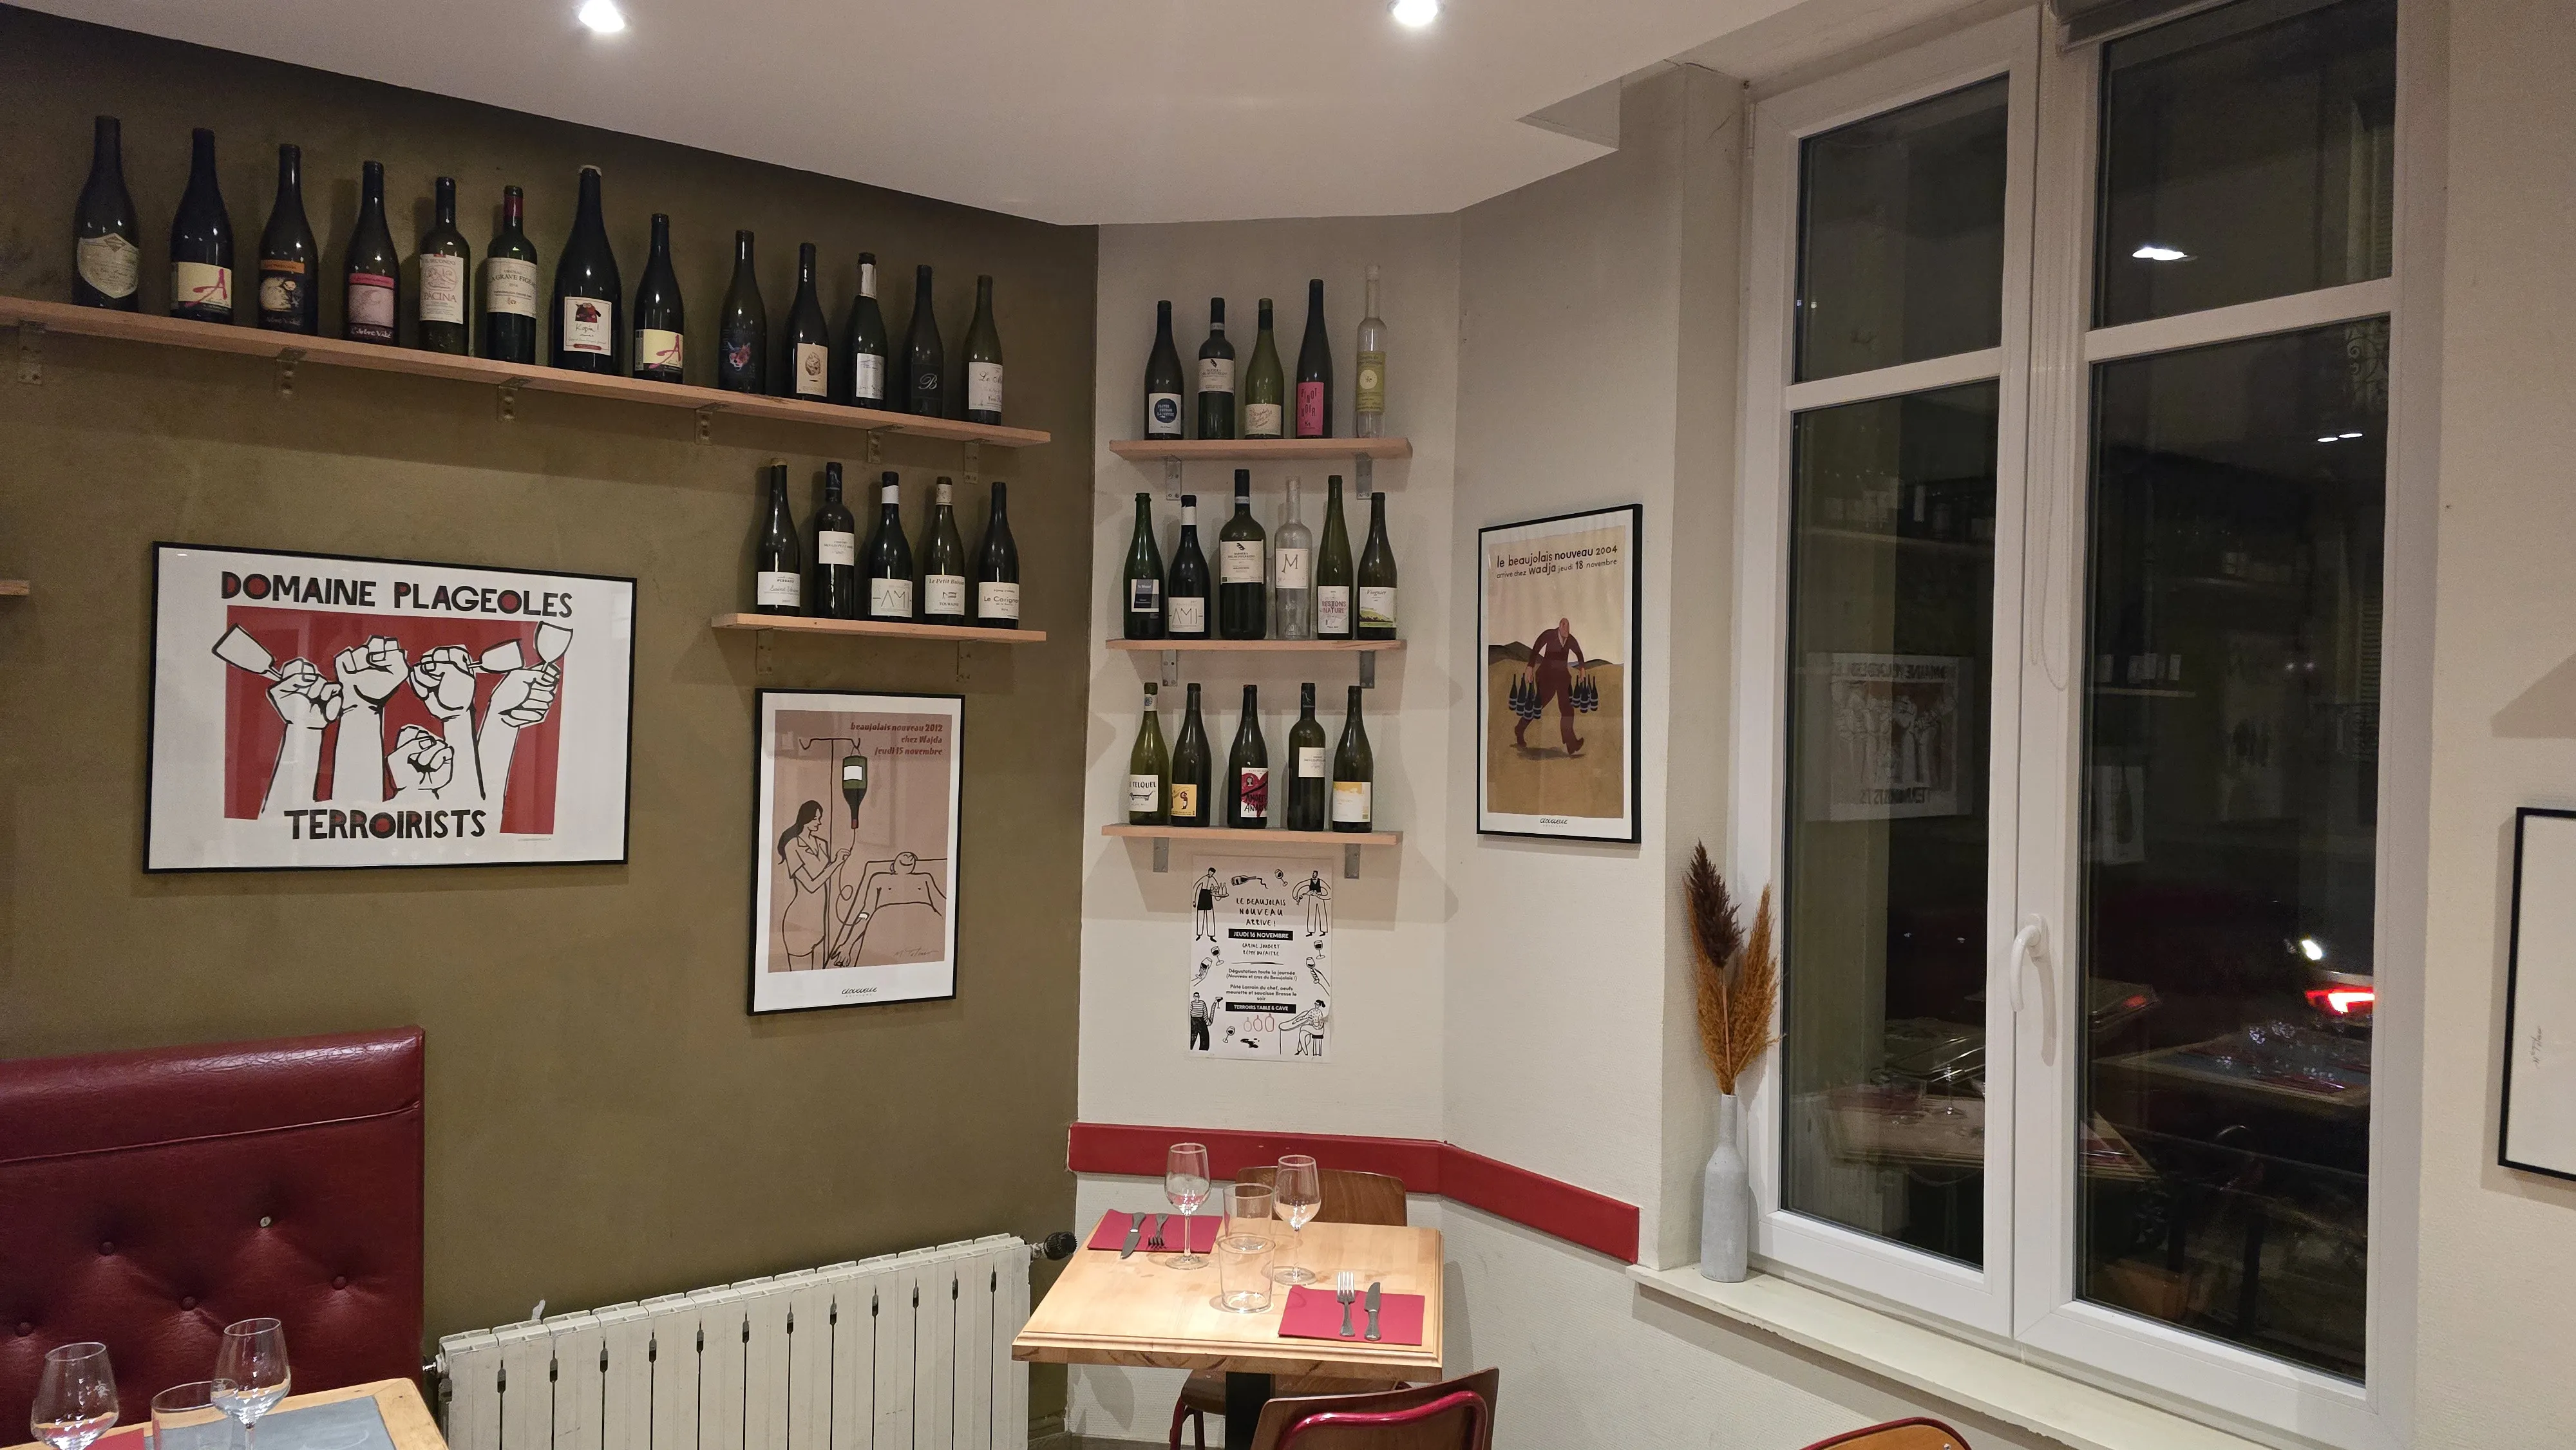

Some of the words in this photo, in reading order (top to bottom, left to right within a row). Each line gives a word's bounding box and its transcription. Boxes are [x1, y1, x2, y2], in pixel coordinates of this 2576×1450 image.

[918, 373, 938, 390] B
[1301, 388, 1317, 403] PINOT
[1282, 554, 1298, 574] M
[1497, 556, 1504, 568] le
[1508, 551, 1553, 567] beaujolais
[1555, 549, 1593, 561] nouveau
[1595, 545, 1618, 556] 2004
[1497, 570, 1513, 579] arrive
[1557, 563, 1573, 573] jeudi
[1575, 560, 1583, 570] 18
[1586, 558, 1617, 568] novembre
[222, 571, 377, 607] DOMAINE
[394, 580, 573, 618] PLAGEOLES
[851, 722, 891, 731] beaujolais
[925, 724, 943, 732] 2012
[920, 735, 942, 744] Wajda
[875, 747, 895, 755] jeudi
[284, 809, 487, 840] TERROIRISTS
